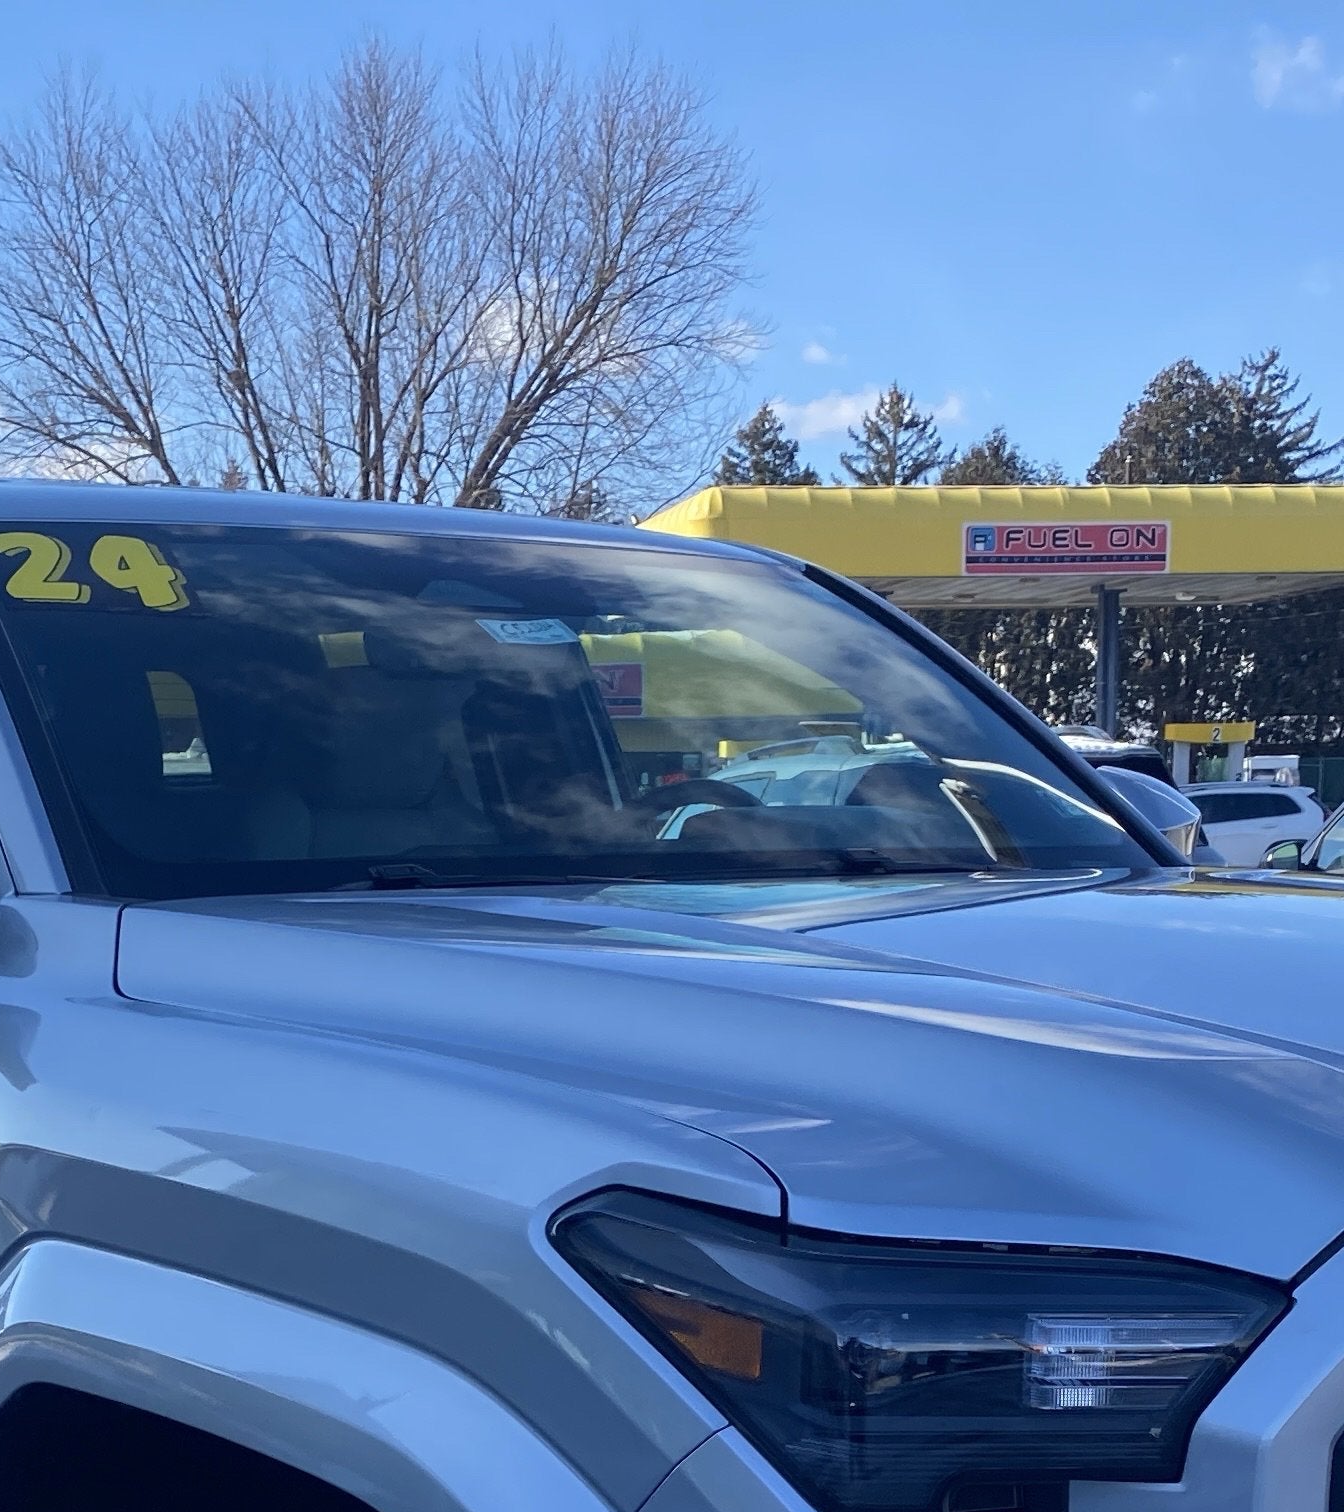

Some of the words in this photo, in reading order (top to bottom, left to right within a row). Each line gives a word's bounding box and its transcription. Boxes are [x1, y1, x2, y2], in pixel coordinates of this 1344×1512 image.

[1005, 528, 1093, 549] FUEL
[1109, 527, 1157, 548] ON
[1212, 727, 1221, 741] 2
